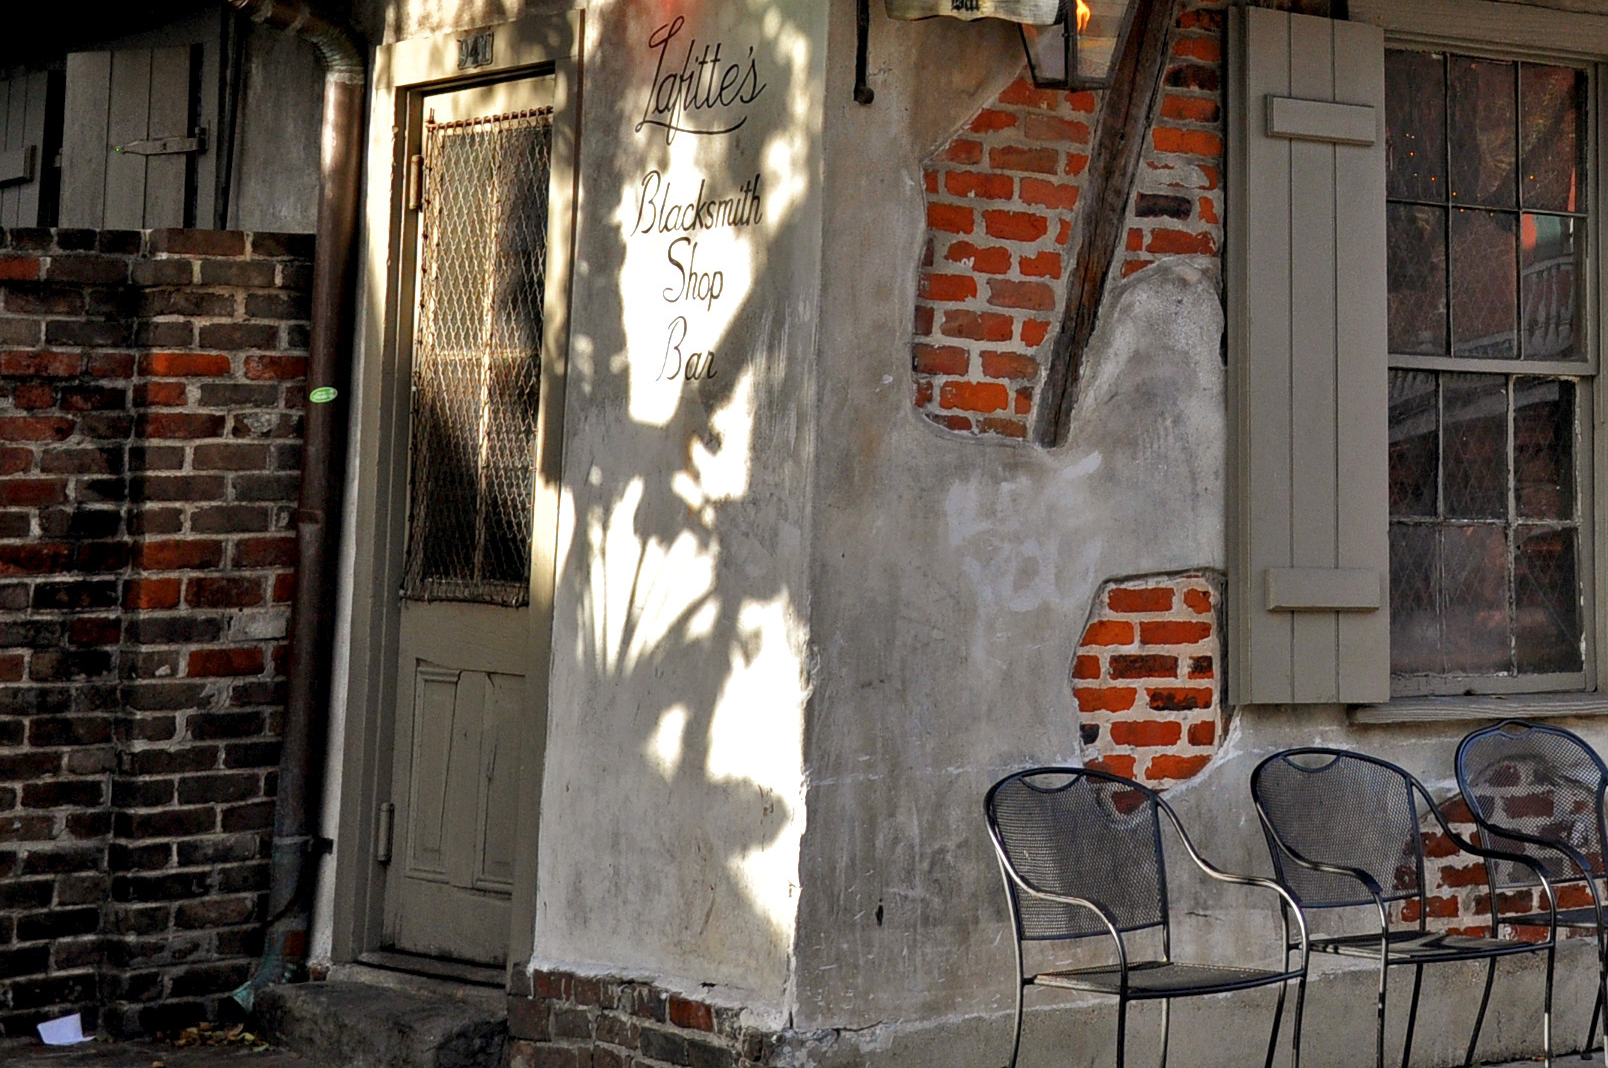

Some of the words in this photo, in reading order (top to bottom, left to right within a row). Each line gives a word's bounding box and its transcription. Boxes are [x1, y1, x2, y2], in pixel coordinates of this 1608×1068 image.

[459, 33, 490, 67] 941
[635, 15, 767, 146] Lafitte's
[630, 169, 763, 237] Blacksmith
[662, 236, 724, 311] Shop
[655, 315, 718, 382] Bar
